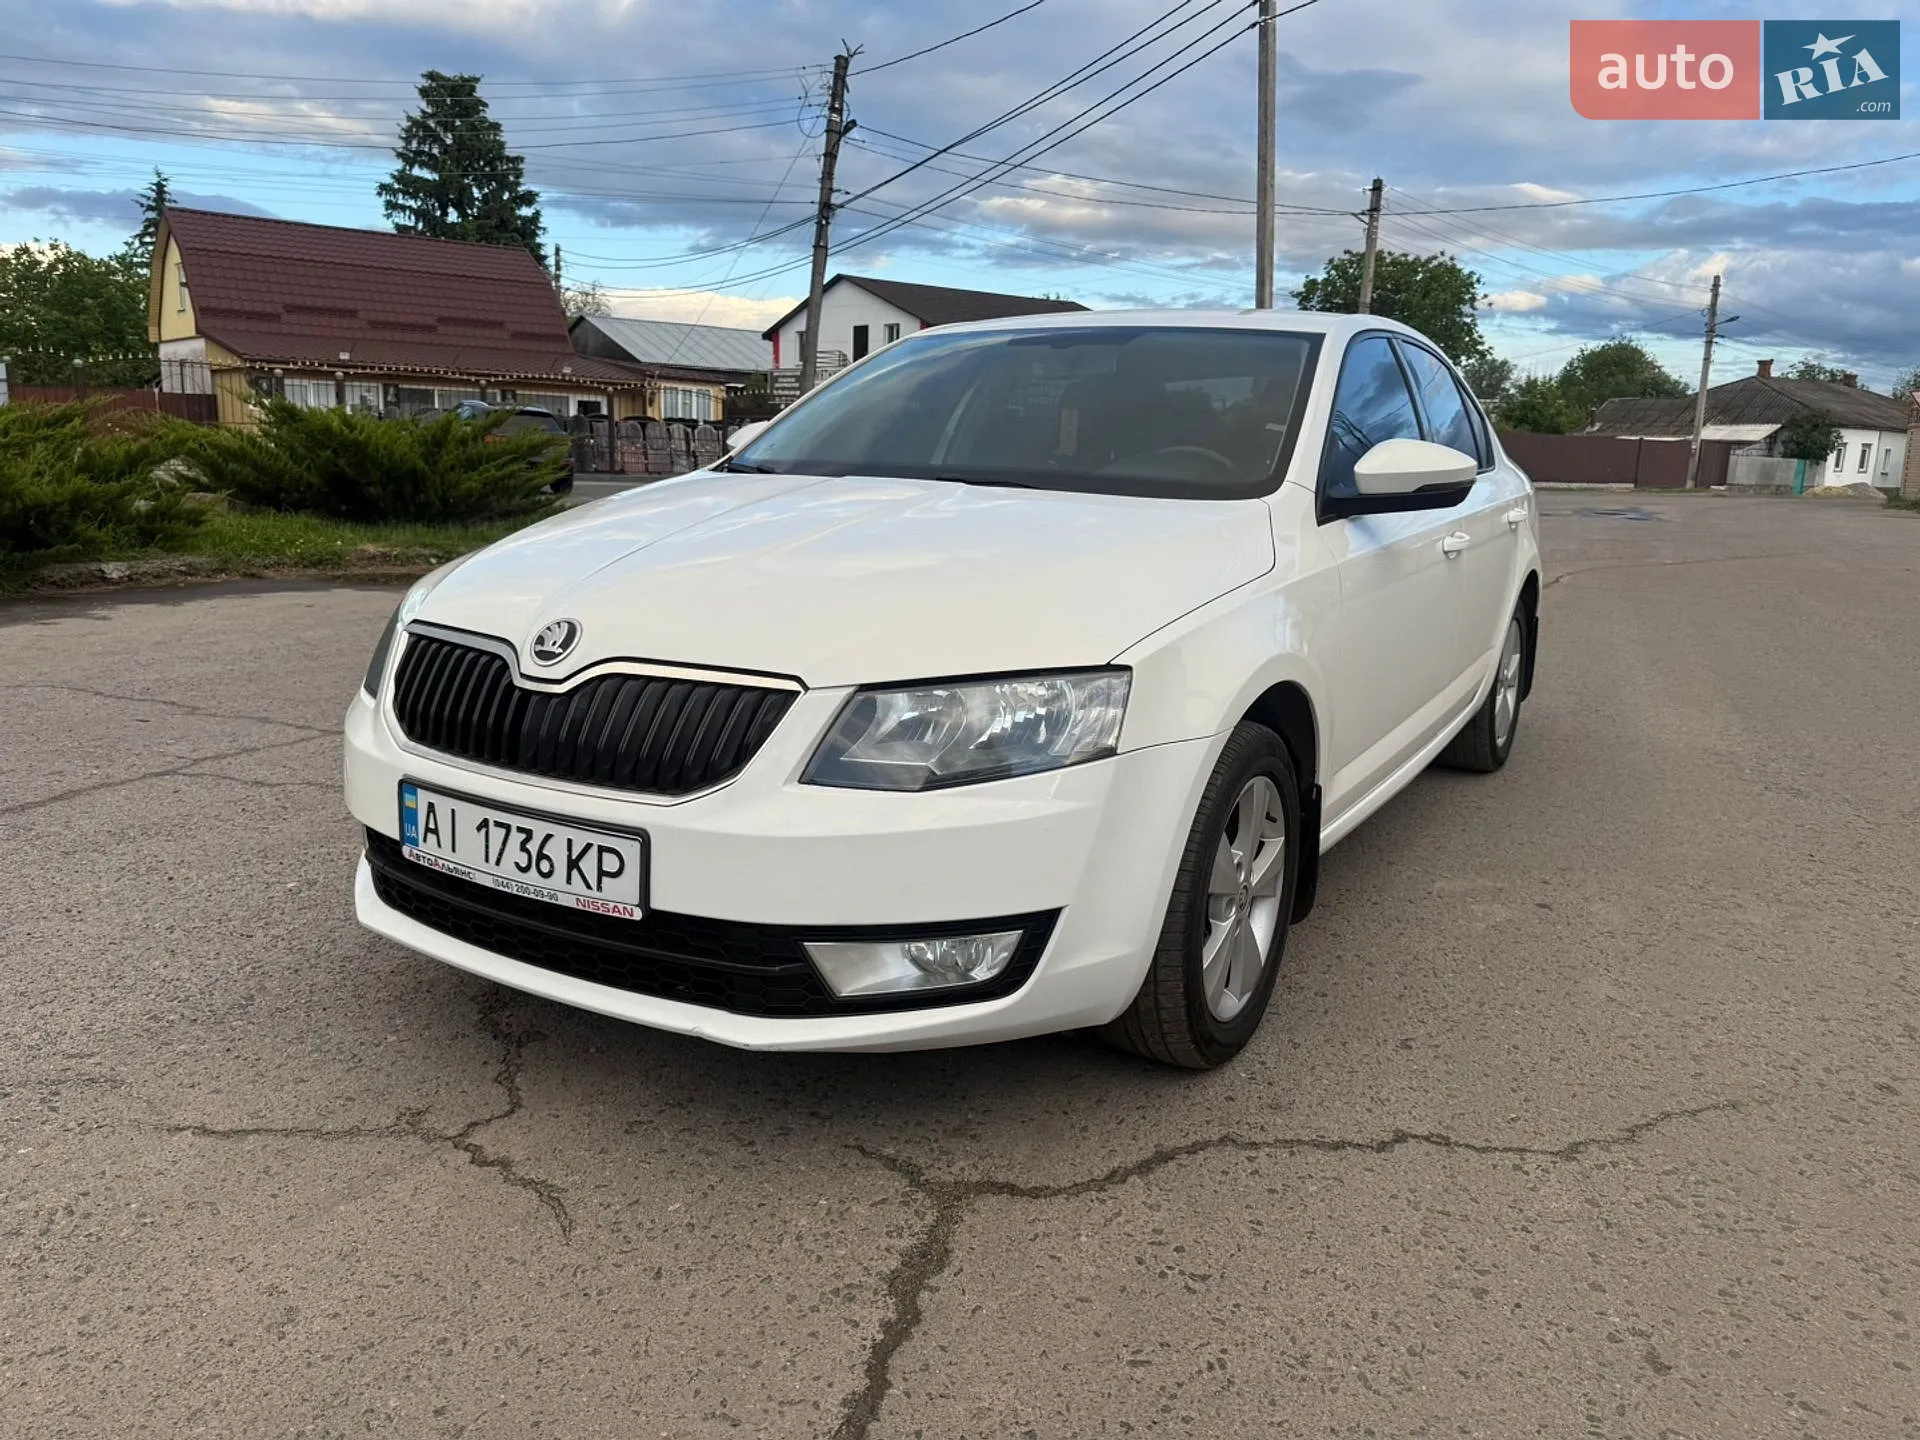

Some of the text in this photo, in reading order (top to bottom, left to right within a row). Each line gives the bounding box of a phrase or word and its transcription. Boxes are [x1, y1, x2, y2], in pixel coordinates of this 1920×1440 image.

[405, 822, 418, 839] UA
[422, 801, 625, 893] AI 1736 KP
[575, 897, 635, 918] NISSAN
